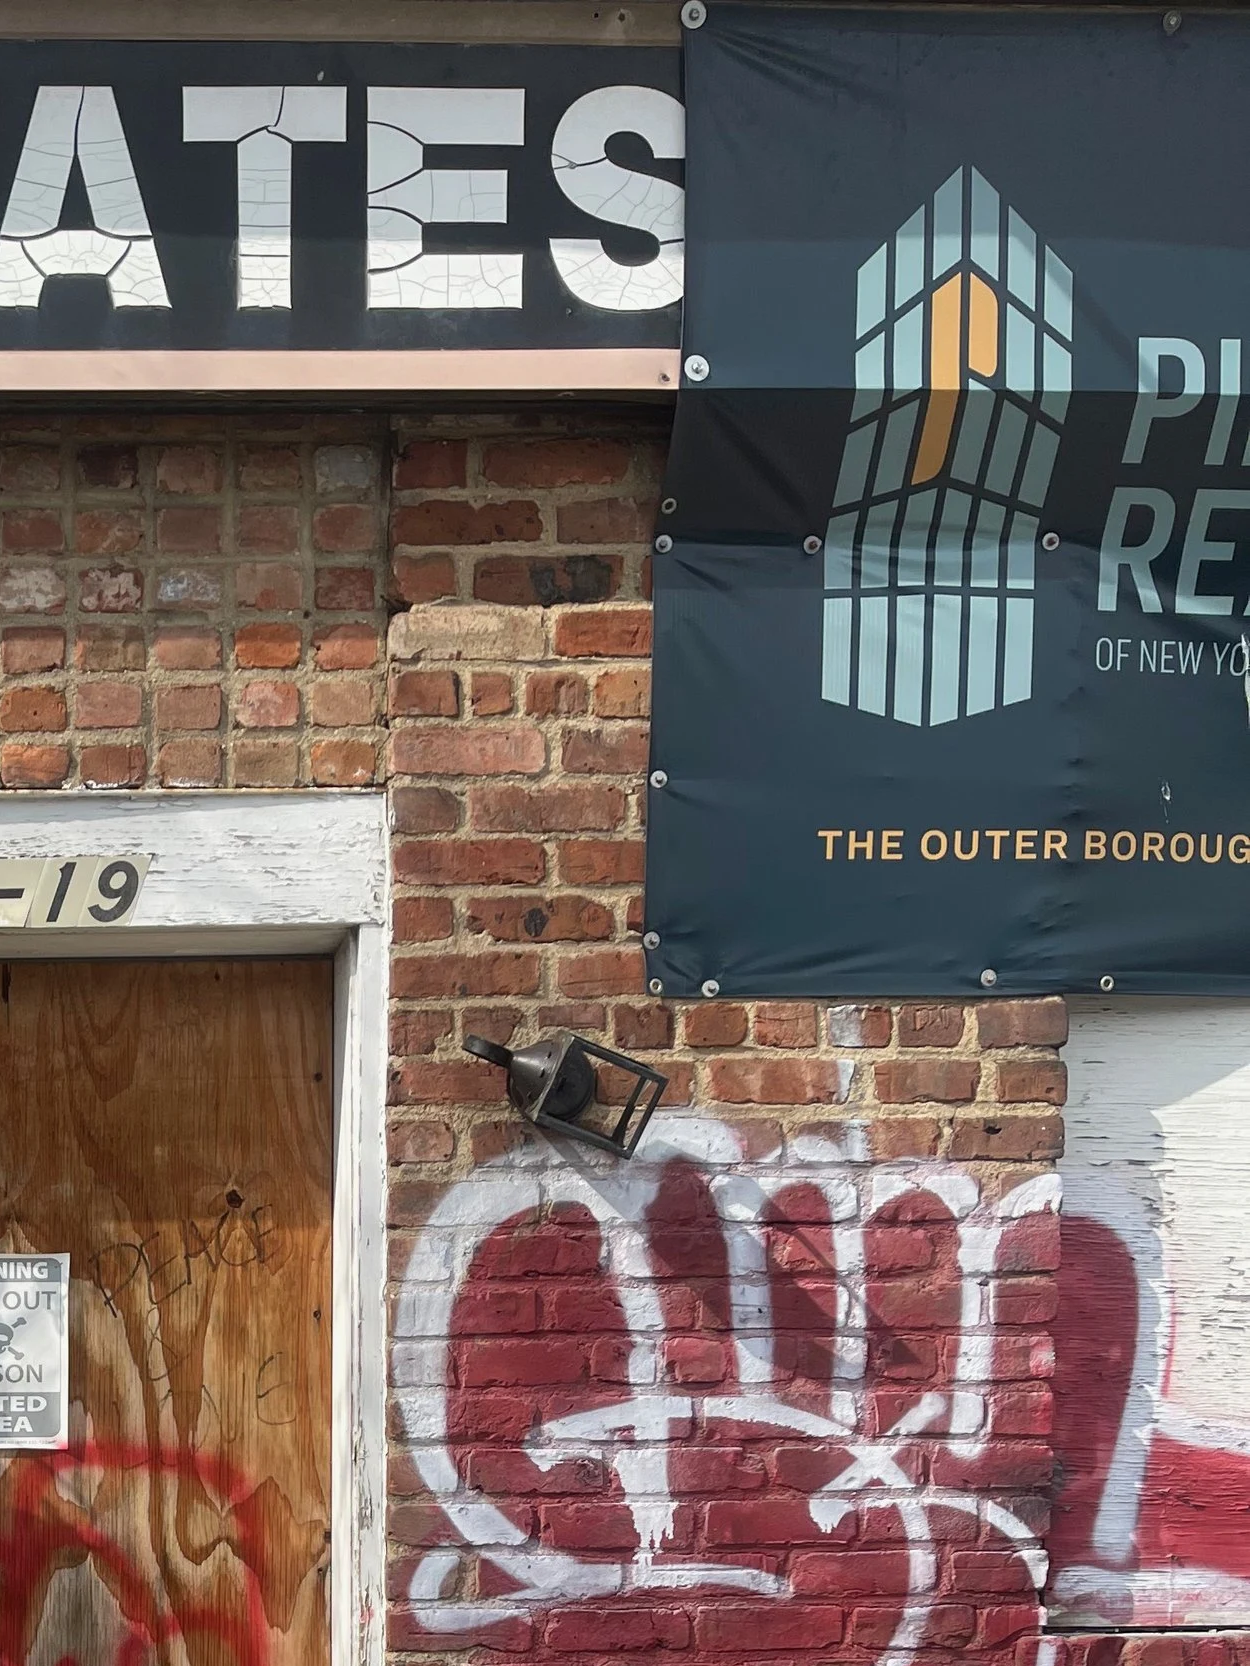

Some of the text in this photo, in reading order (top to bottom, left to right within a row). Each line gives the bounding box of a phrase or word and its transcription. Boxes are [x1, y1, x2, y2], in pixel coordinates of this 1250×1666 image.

[1098, 486, 1250, 616] RE
[1096, 637, 1131, 672] OF
[1138, 639, 1204, 675] NEW
[818, 829, 1250, 864] THE OUTER BOROUG
[3, 1290, 56, 1310] OUT
